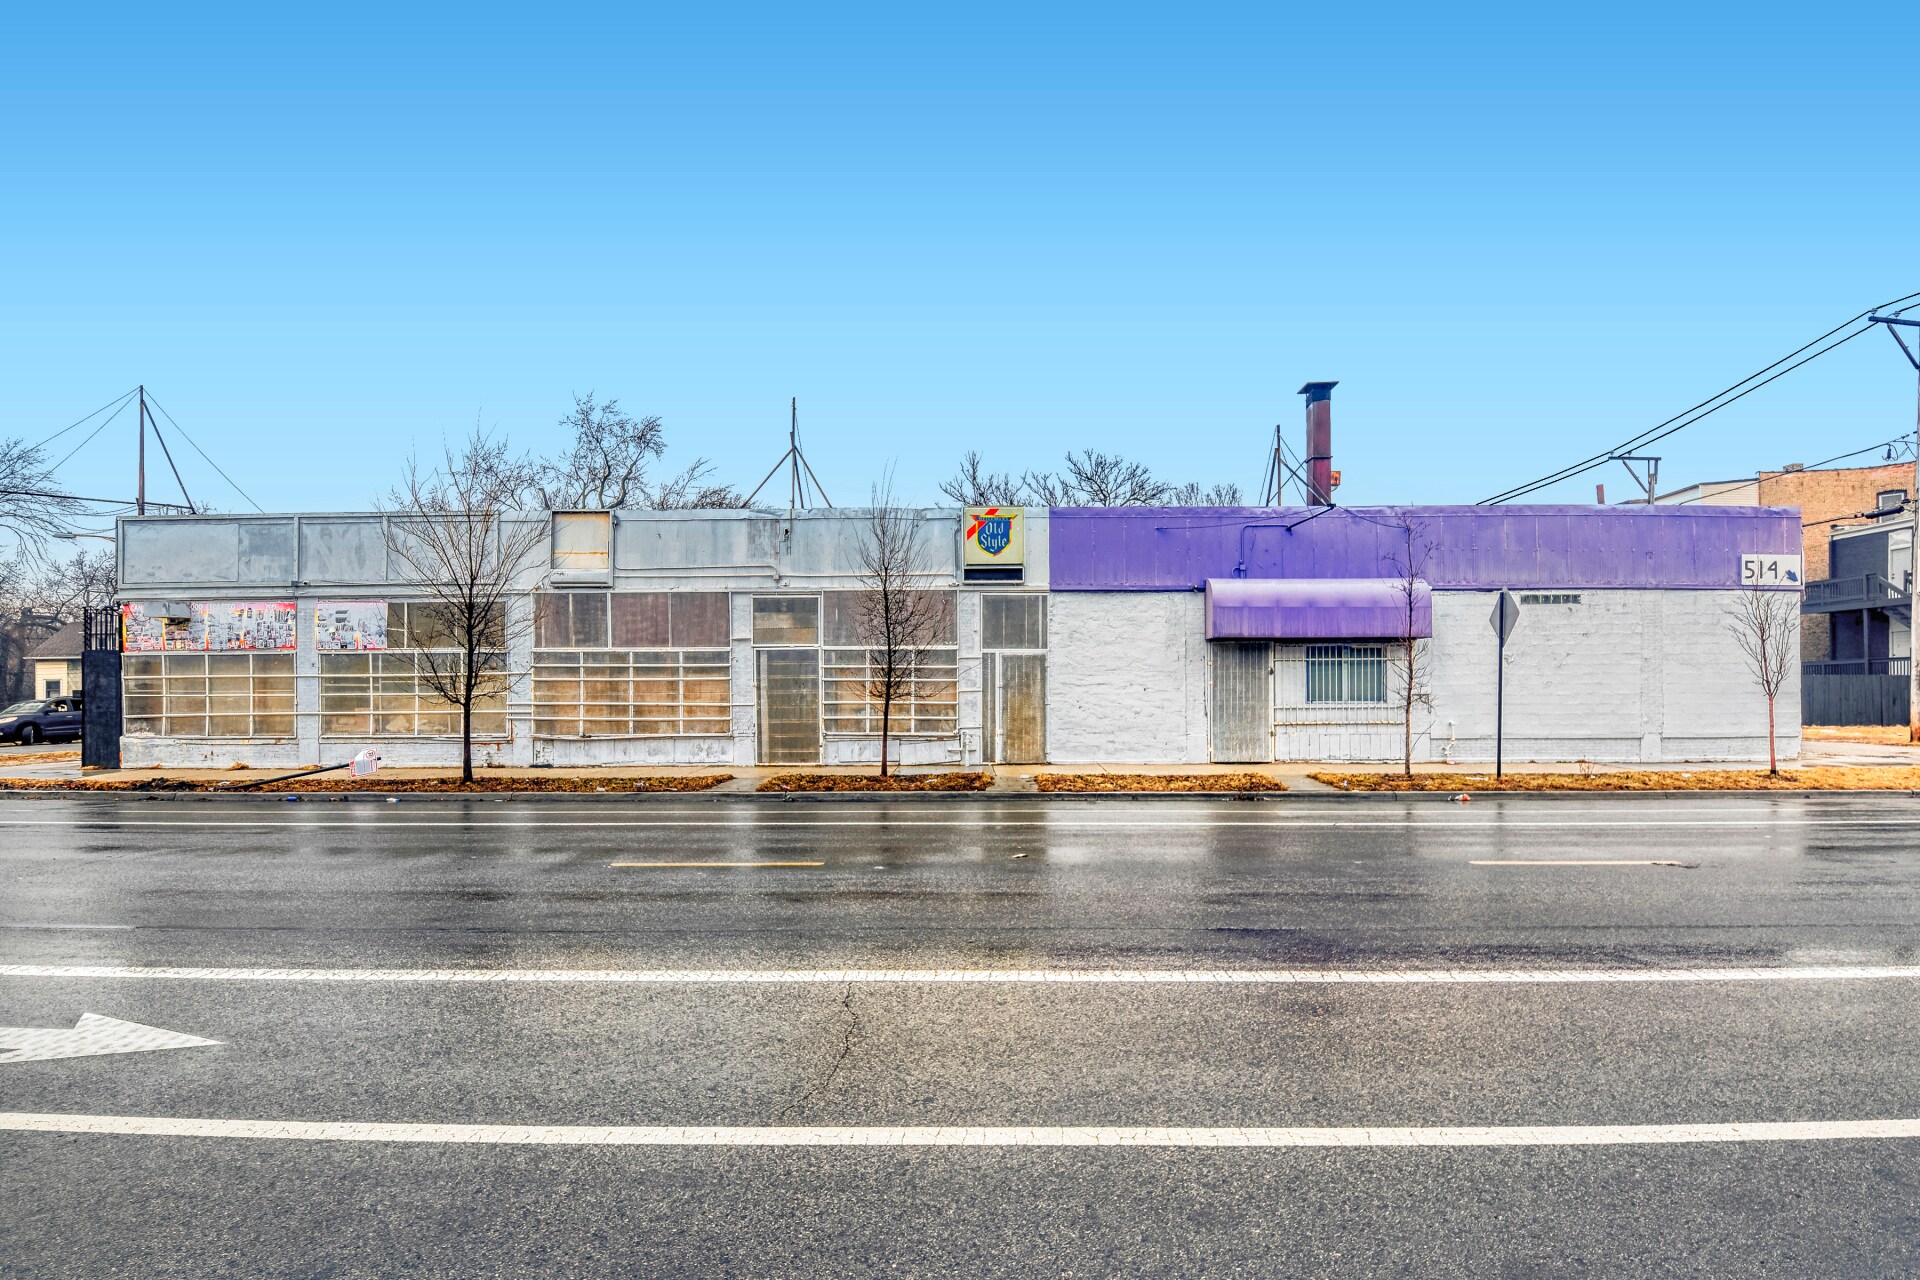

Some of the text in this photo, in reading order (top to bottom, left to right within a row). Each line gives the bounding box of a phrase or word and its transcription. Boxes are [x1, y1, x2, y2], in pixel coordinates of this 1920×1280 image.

[985, 522, 1004, 535] Old
[980, 533, 1008, 552] Style
[1744, 560, 1778, 580] 514
